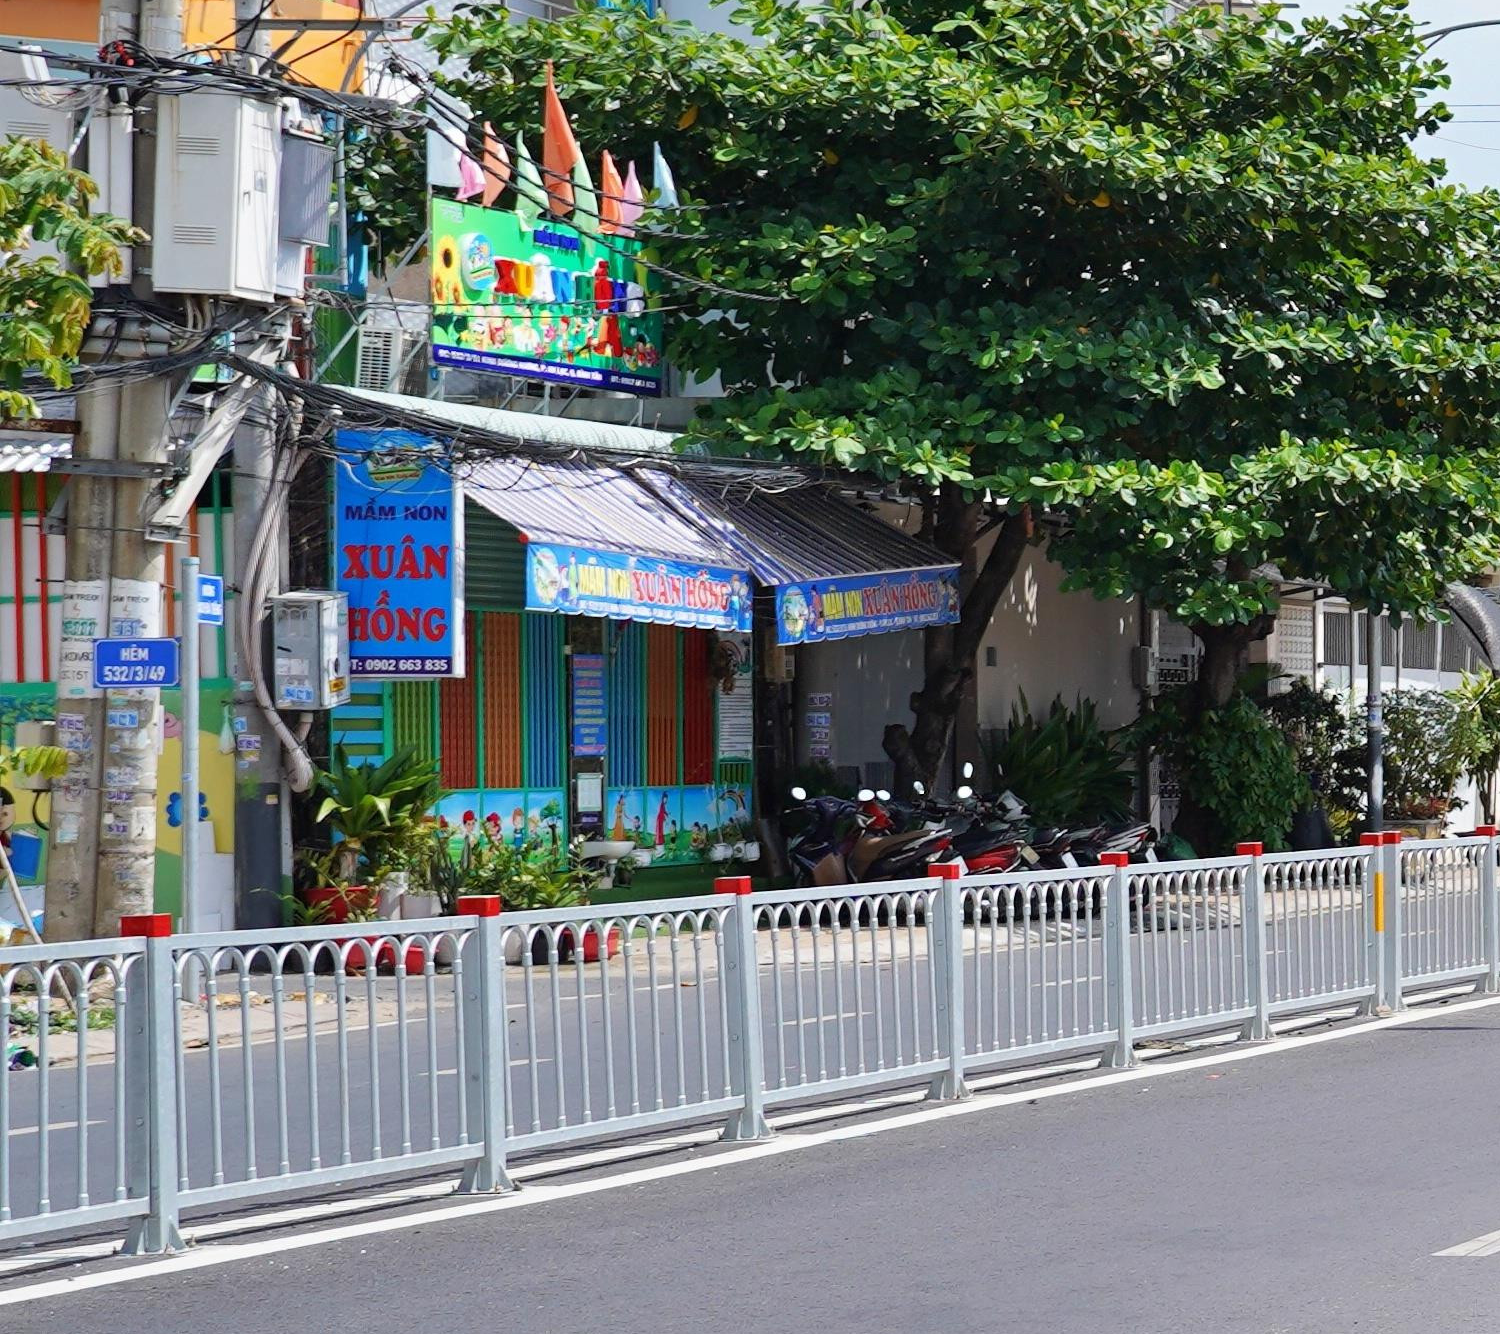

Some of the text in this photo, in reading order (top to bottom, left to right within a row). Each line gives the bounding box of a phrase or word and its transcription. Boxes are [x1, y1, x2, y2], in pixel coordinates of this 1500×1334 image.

[404, 505, 447, 521] NON
[343, 535, 449, 580] XUÂN
[631, 565, 681, 604] XUÂN
[863, 578, 899, 616] XUÂN
[348, 590, 447, 642] HỒNG
[103, 665, 165, 682] 532/3/49
[365, 659, 396, 671] 0902
[399, 659, 422, 671] 663
[425, 659, 448, 671] 835
